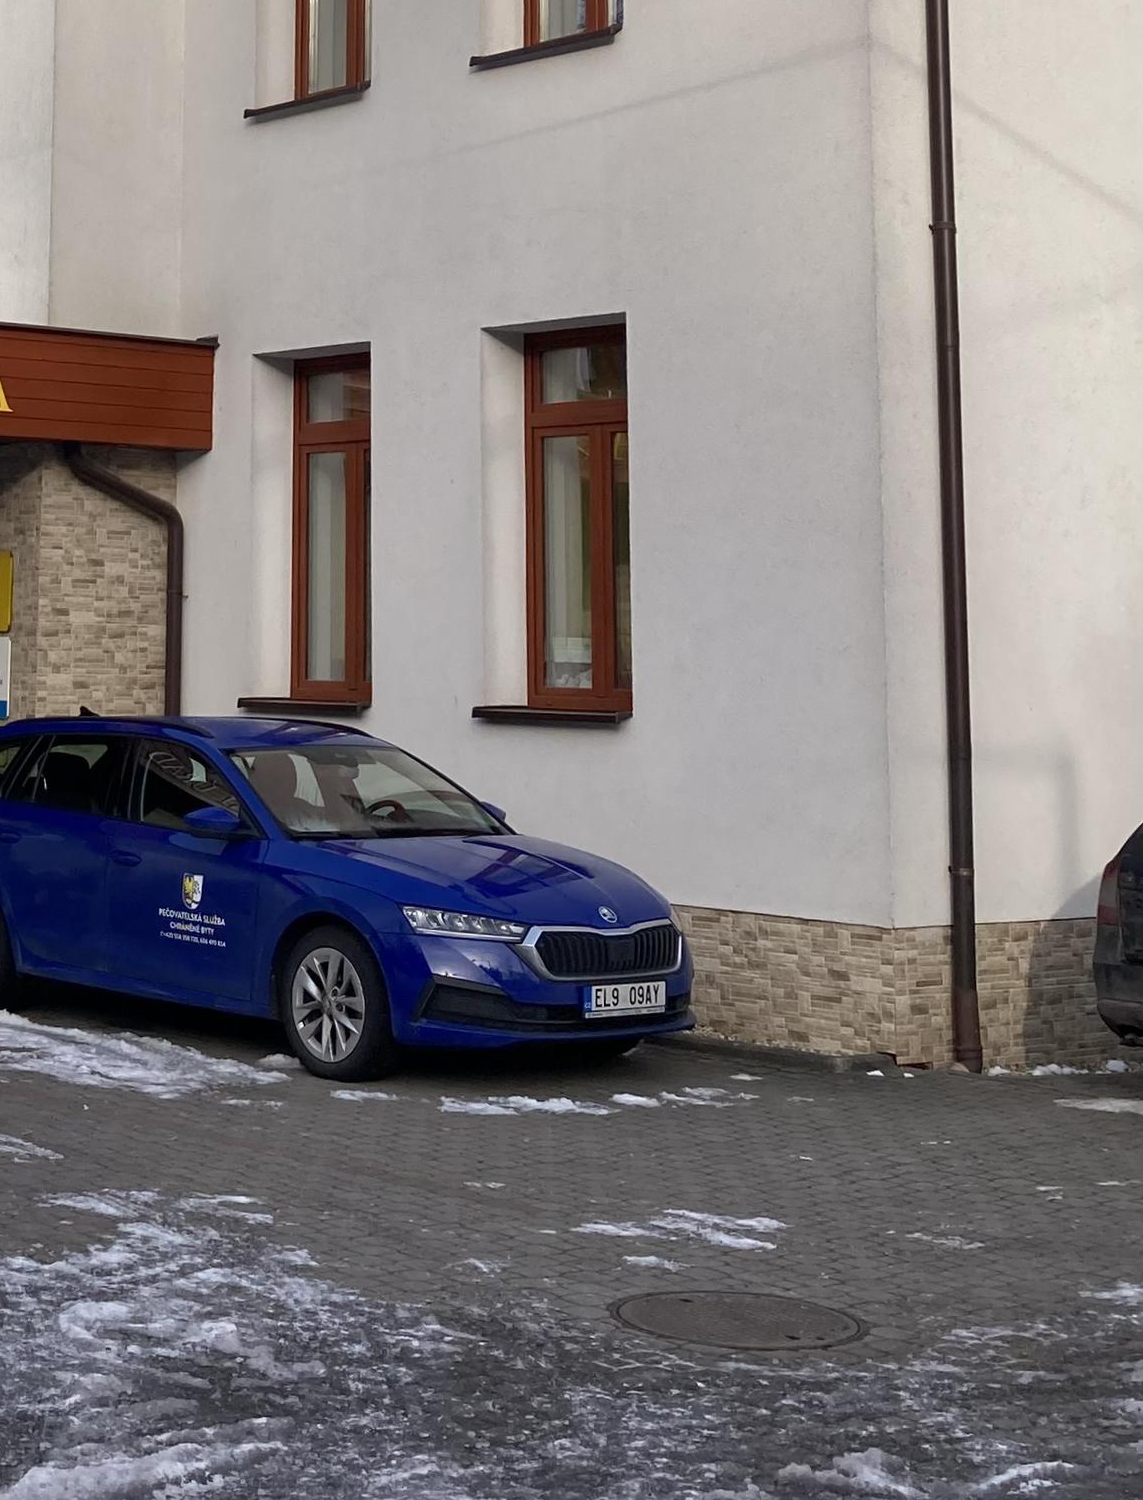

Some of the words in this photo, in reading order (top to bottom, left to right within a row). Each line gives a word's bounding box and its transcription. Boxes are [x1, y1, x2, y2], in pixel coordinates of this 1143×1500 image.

[159, 908, 202, 922] PEČOVATELSKÁ
[203, 915, 225, 925] SLUŽBA
[595, 987, 619, 1008] EL9
[629, 984, 660, 1005] 09AY
